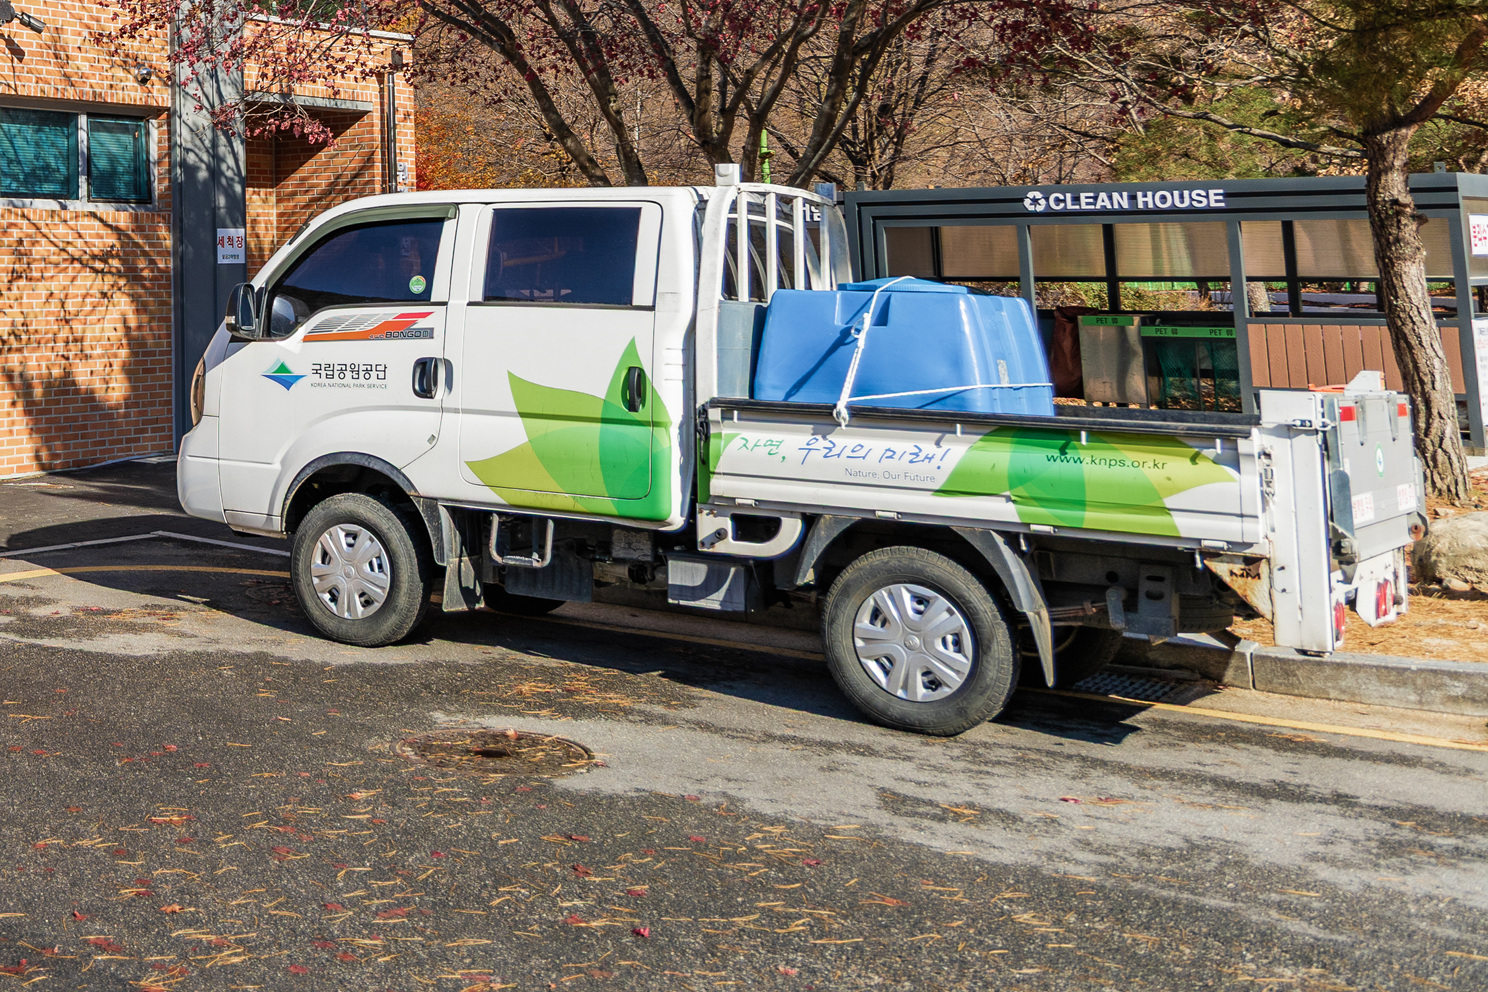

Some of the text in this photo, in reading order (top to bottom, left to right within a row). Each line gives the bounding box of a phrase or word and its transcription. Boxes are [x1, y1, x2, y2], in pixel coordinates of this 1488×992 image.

[1049, 189, 1226, 210] CLEAN HOUSE
[385, 330, 421, 339] BONGO
[311, 363, 388, 380] 국립공원공단
[798, 437, 872, 465] 우리의
[878, 444, 951, 470] 미래!
[1046, 454, 1168, 470] www.knps.or.kr
[845, 468, 936, 483] Nature, Our Future
